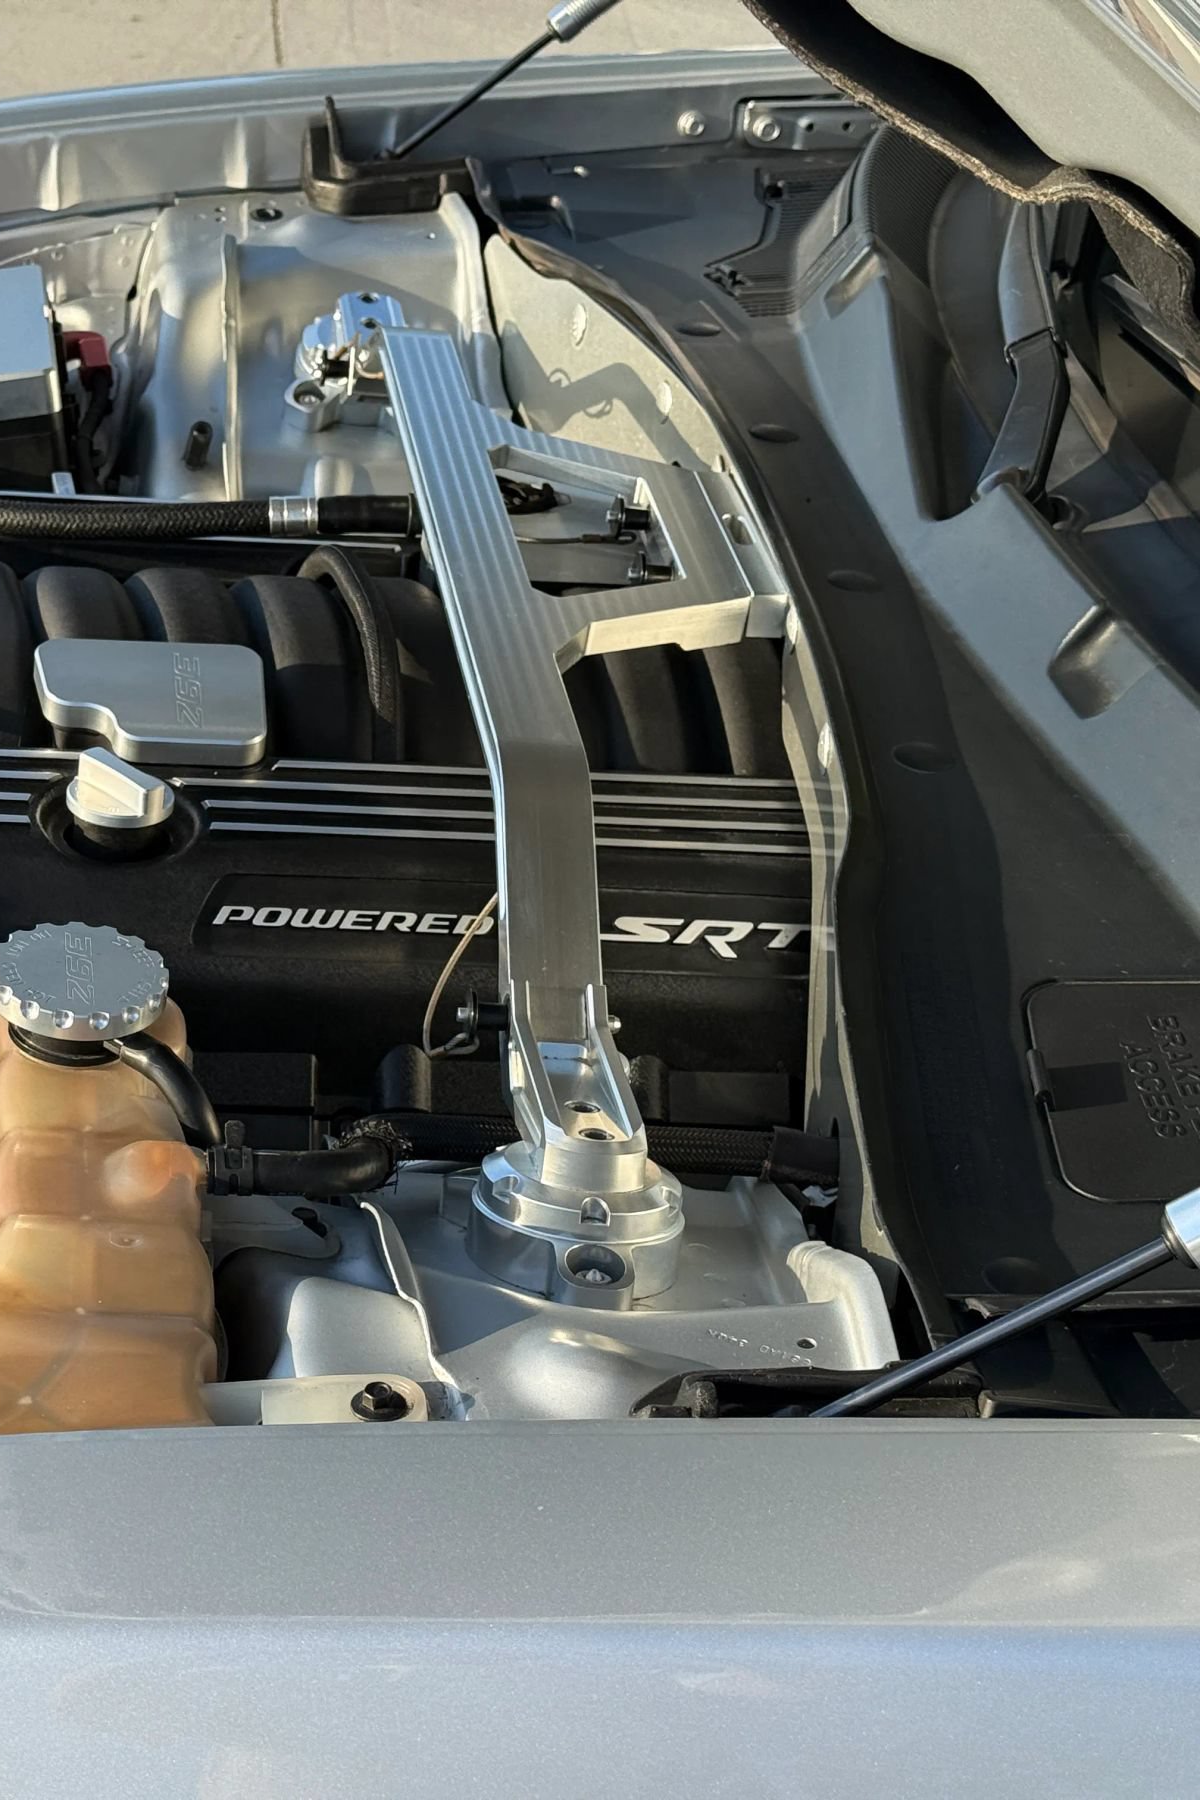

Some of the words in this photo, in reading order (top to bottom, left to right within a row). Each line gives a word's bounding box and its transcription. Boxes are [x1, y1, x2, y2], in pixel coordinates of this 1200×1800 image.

[212, 904, 494, 936] POWERED
[600, 916, 813, 959] SRT
[1118, 1041, 1187, 1138] ACCESS
